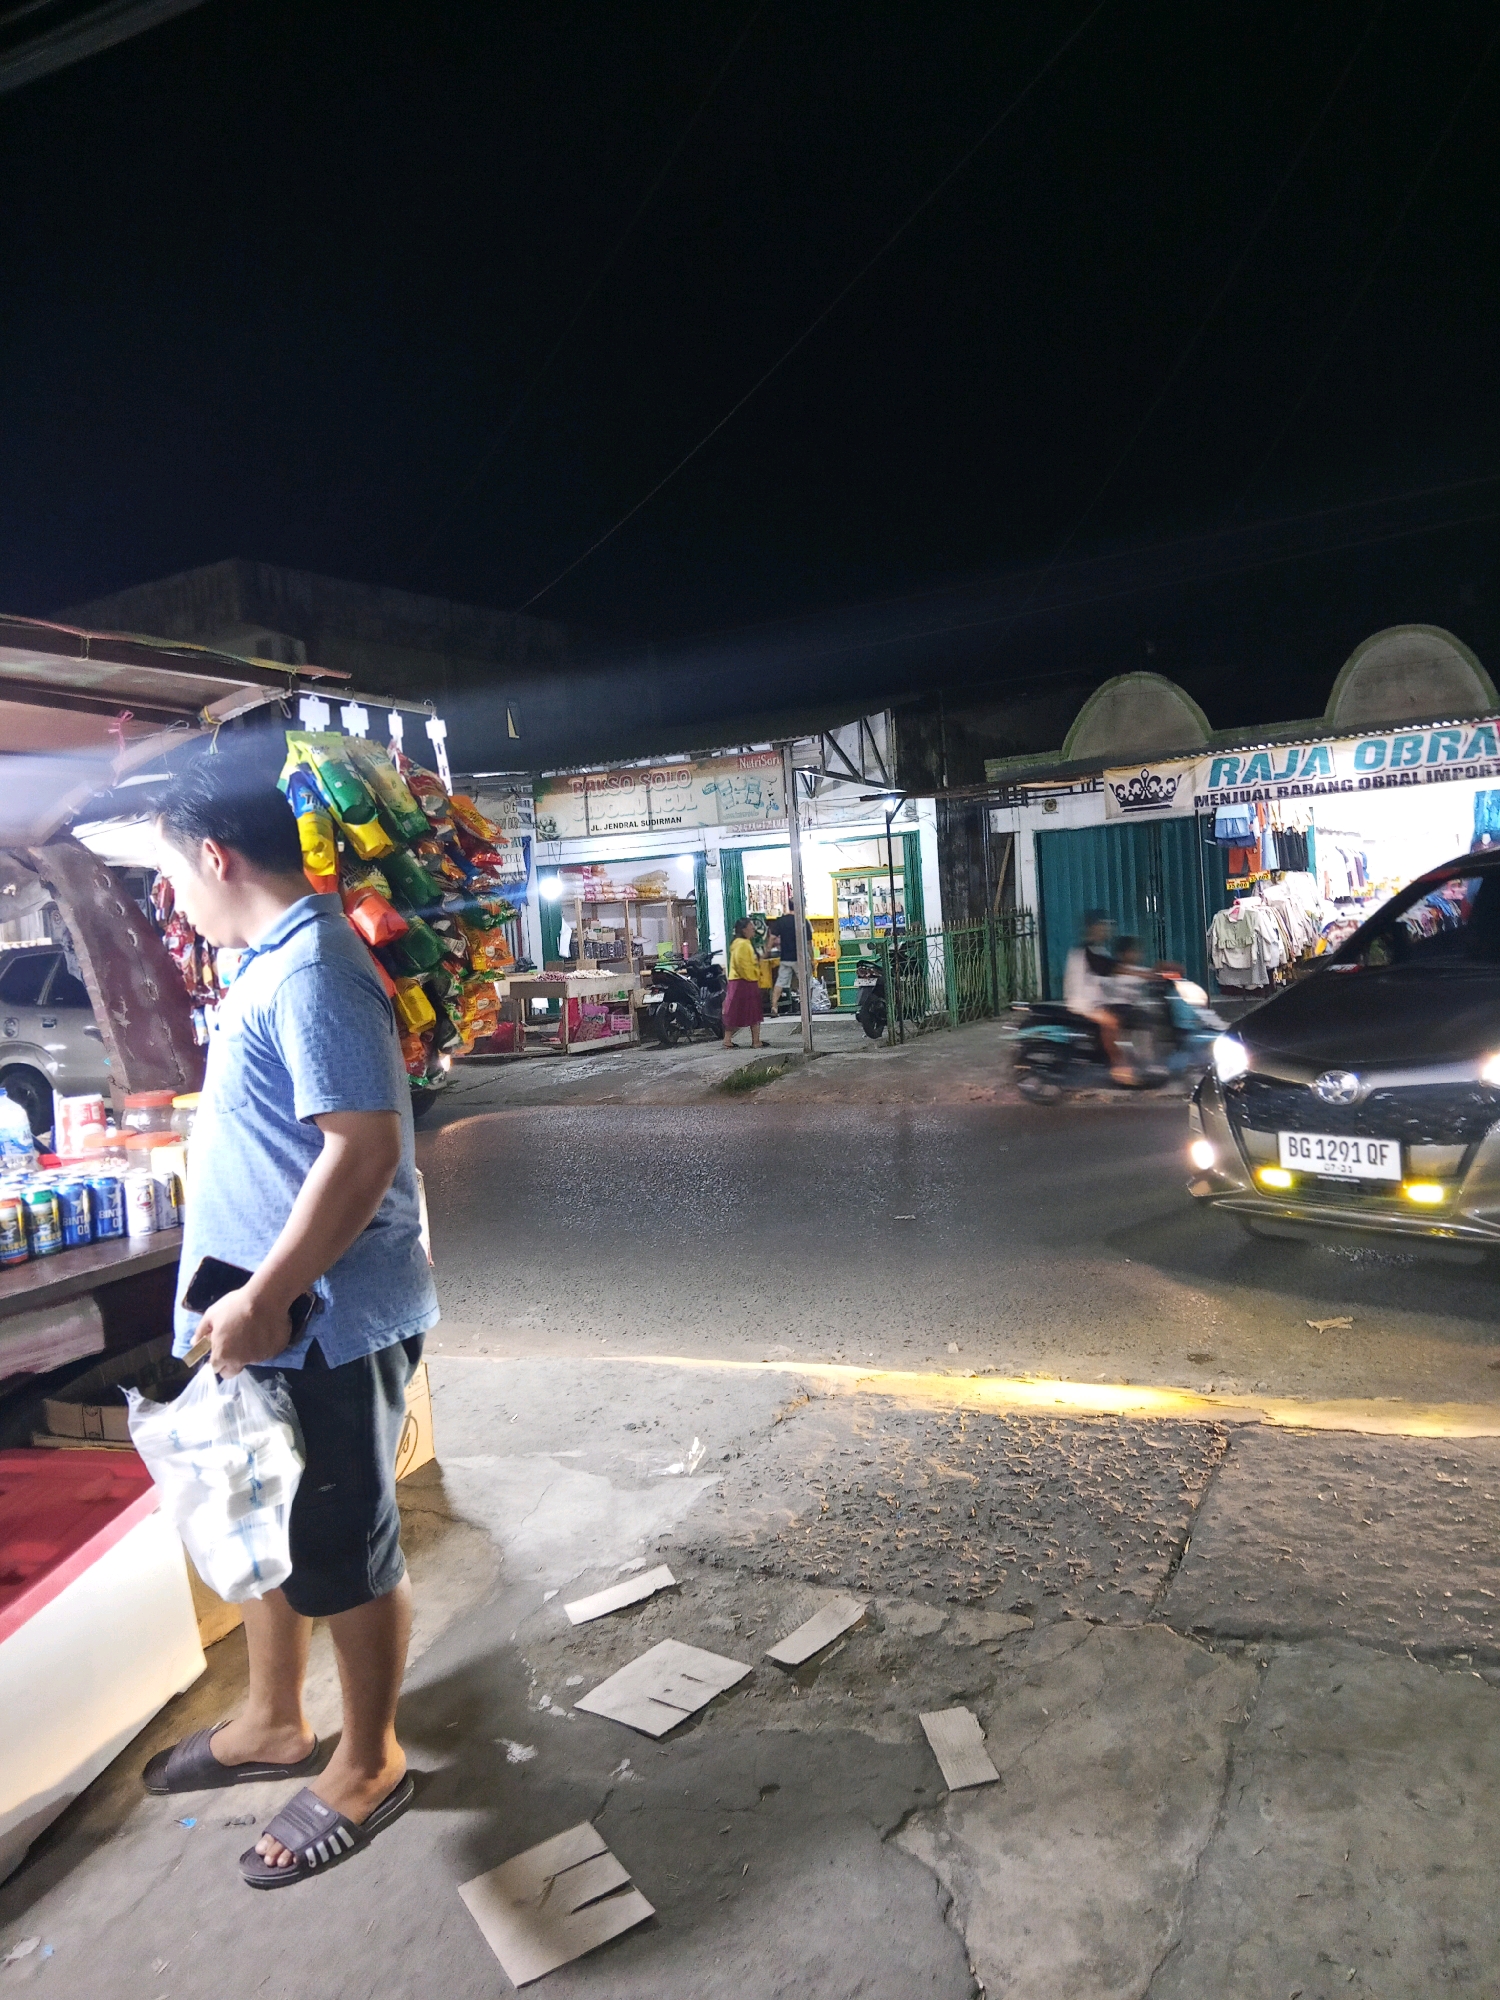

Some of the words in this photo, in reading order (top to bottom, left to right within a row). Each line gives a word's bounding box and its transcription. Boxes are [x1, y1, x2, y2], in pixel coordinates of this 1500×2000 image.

[738, 755, 782, 769] NutriSari
[1208, 745, 1336, 792] RAJA
[571, 775, 635, 799] BAKSO
[638, 768, 692, 792] SOLO
[1194, 788, 1272, 808] MENJUAL
[1276, 778, 1354, 799] BARANG
[1358, 771, 1422, 790] OBRAL
[590, 823, 603, 832] JL.
[603, 819, 639, 831] JENDRAL
[640, 816, 682, 828] SUDIRMAN
[1288, 1136, 1311, 1158] BG
[1315, 1138, 1361, 1164] 1291
[1367, 1143, 1389, 1166] QF
[98, 1208, 122, 1219] BINT
